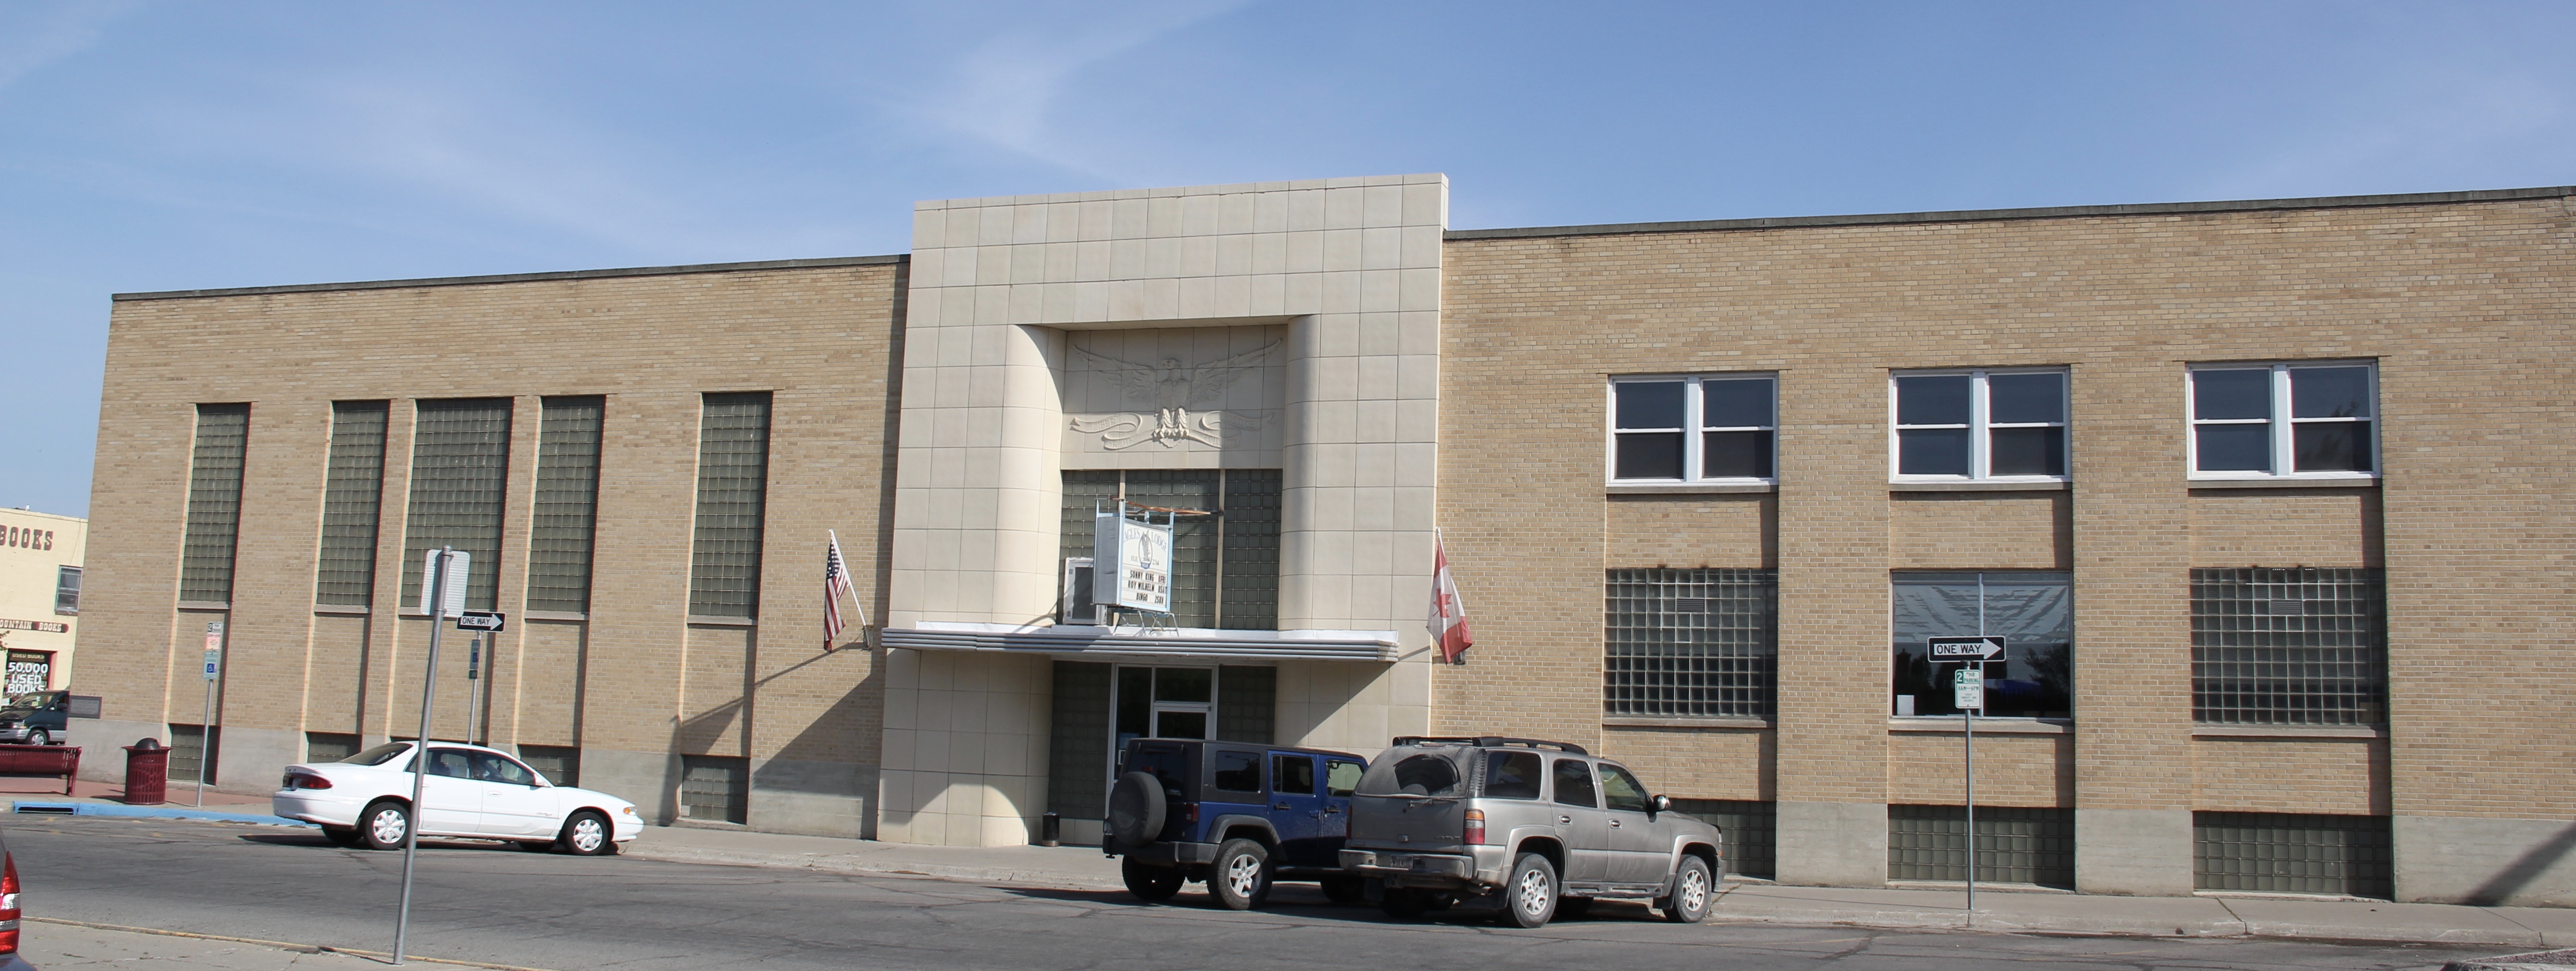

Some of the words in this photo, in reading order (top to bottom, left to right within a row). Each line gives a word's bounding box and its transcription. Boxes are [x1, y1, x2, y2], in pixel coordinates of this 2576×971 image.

[1130, 570, 1143, 580] SONNY
[1145, 573, 1154, 582] KING
[1128, 580, 1137, 589] ROY
[1136, 593, 1148, 601] BINGO
[38, 622, 62, 632] BOOKS
[1936, 645, 1956, 654] ONE
[1960, 644, 1981, 654] WAY
[11, 673, 42, 684] USED
[1957, 672, 1962, 682] 2
